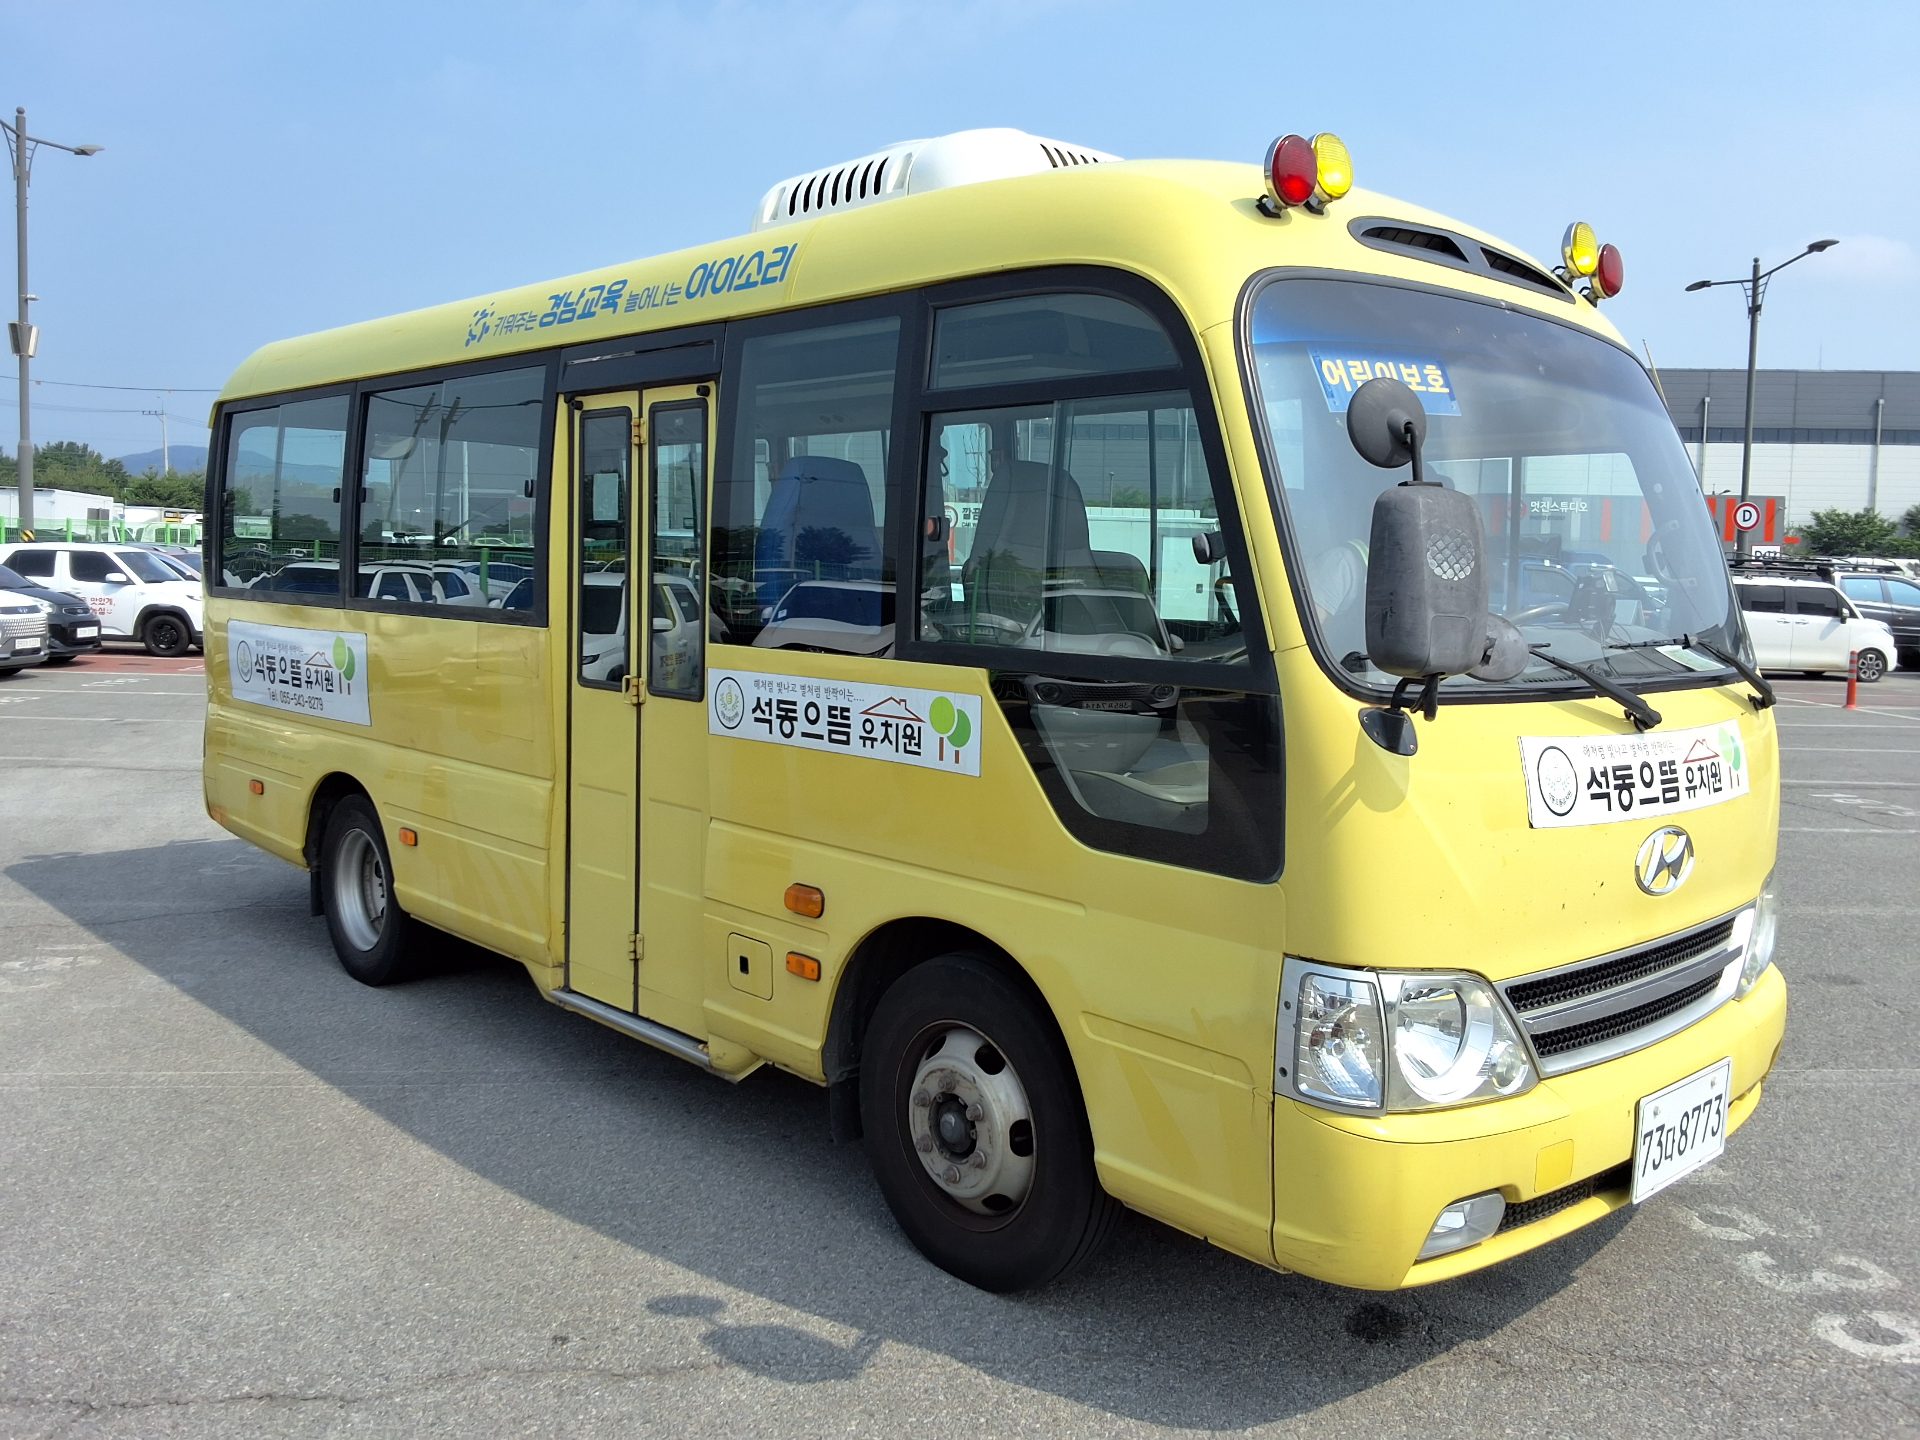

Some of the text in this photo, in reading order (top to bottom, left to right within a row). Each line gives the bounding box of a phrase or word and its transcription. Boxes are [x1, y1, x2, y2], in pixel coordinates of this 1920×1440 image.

[493, 243, 798, 336] 키워주는 경남교육 늘어나는 아이소리
[1530, 501, 1588, 513] 멋진스튜디오
[1743, 510, 1752, 522] D
[255, 653, 334, 693] 석동으뜸 유치원
[751, 696, 922, 756] 석동으뜸 유치원
[1587, 760, 1723, 812] 석동으뜸 유치원
